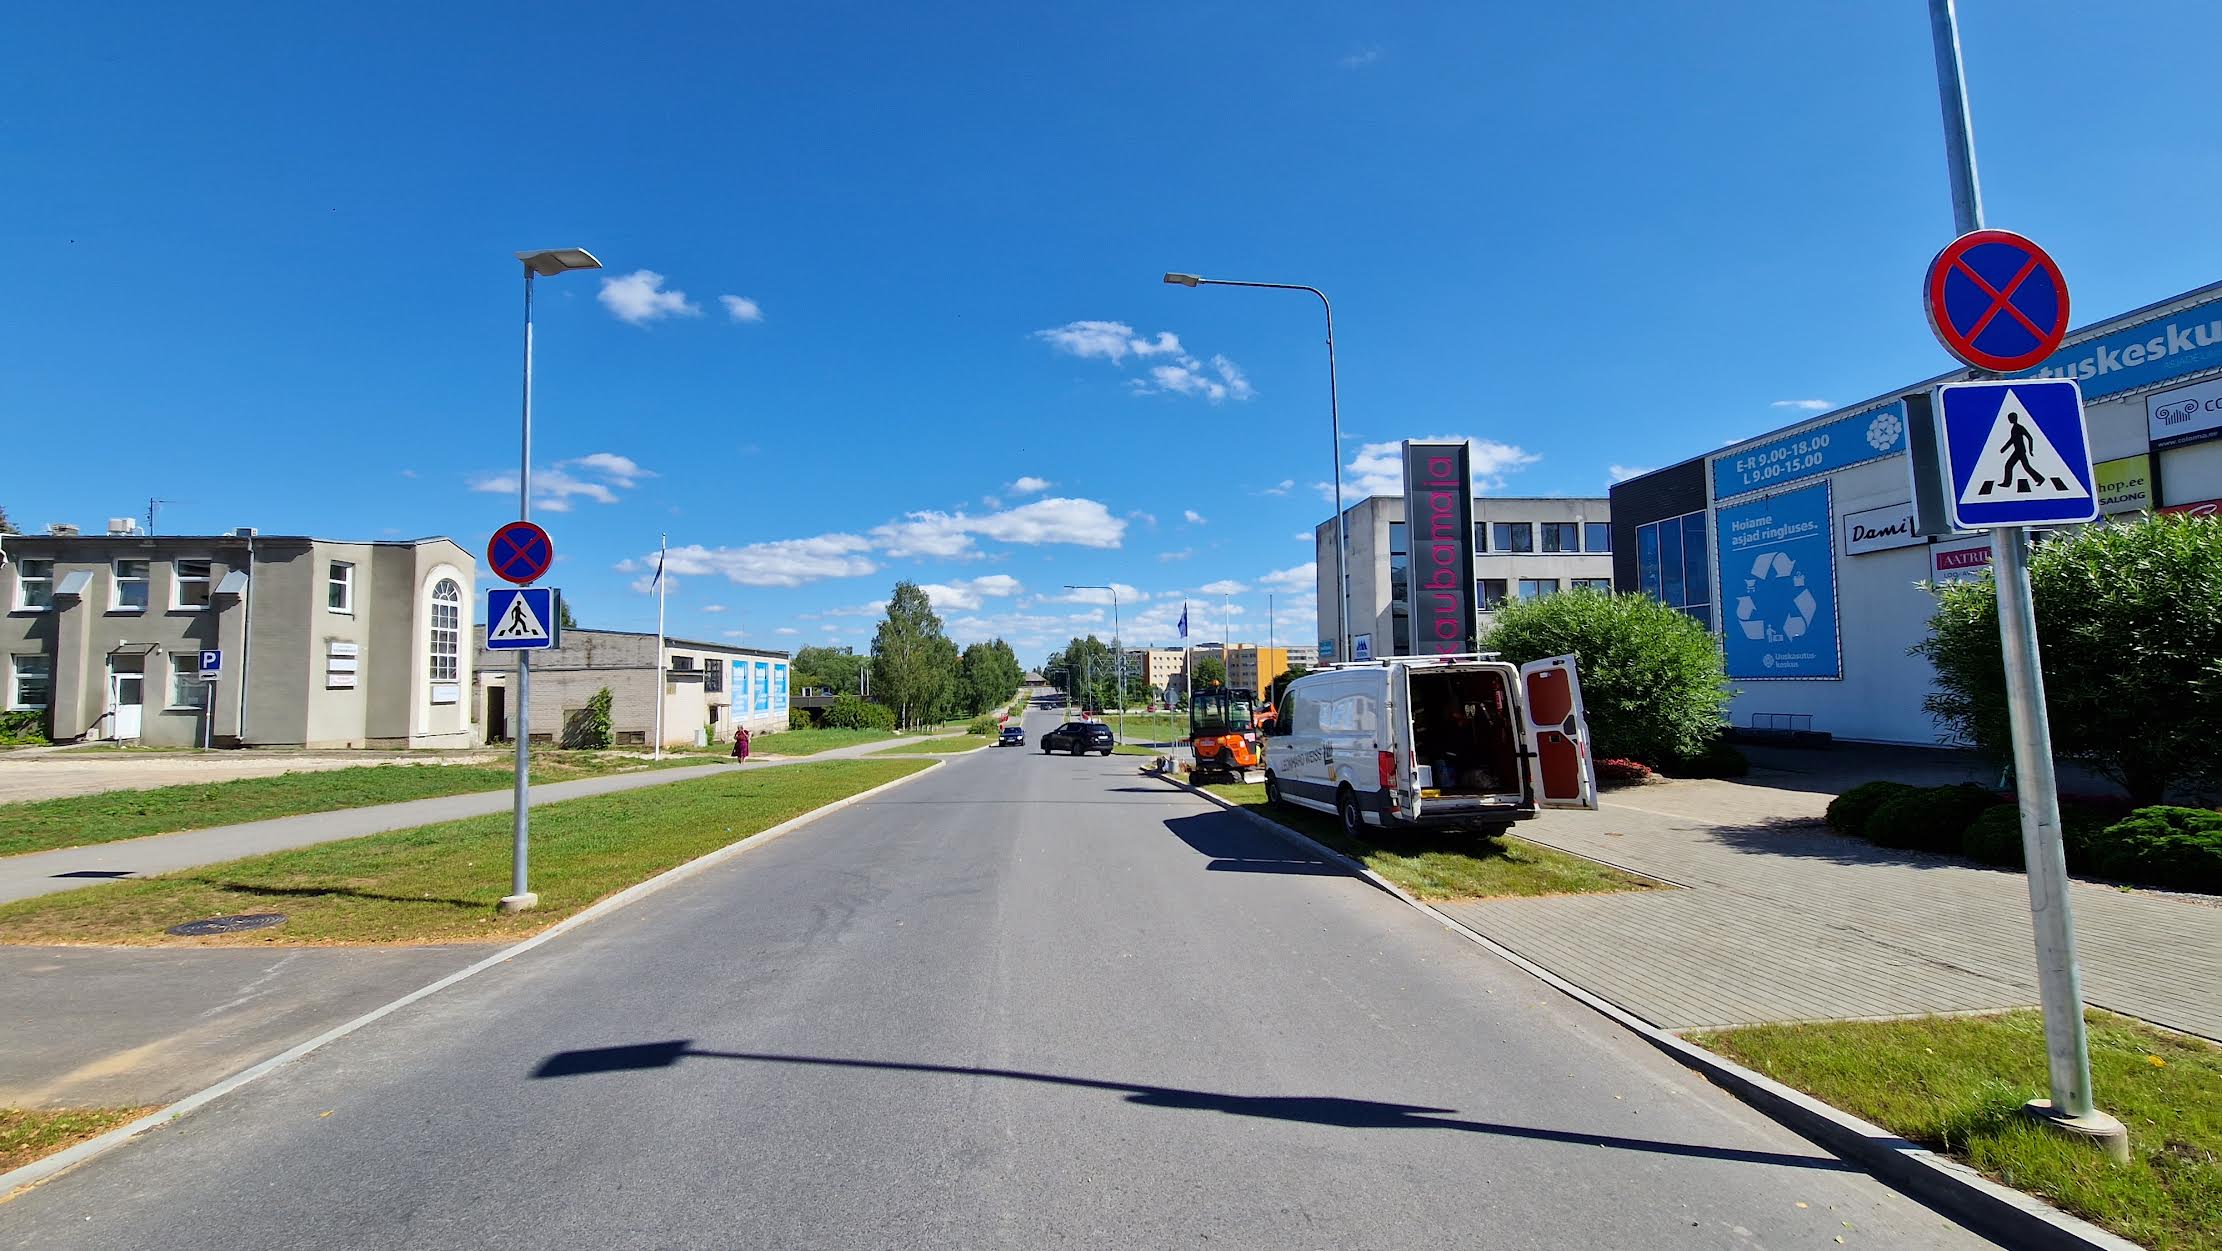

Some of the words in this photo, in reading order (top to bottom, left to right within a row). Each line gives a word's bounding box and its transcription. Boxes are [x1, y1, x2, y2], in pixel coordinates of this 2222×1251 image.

[1736, 458, 1756, 473] E-R
[1758, 433, 1830, 465] 9.00-18.00
[1743, 471, 1751, 485] L
[1752, 451, 1823, 482] 9.00-15.00
[2100, 491, 2146, 506] SALONG
[1731, 515, 1773, 532] Hoiame
[1731, 529, 1760, 546] asjad
[1761, 520, 1819, 540] ringluses.
[203, 652, 216, 668] P
